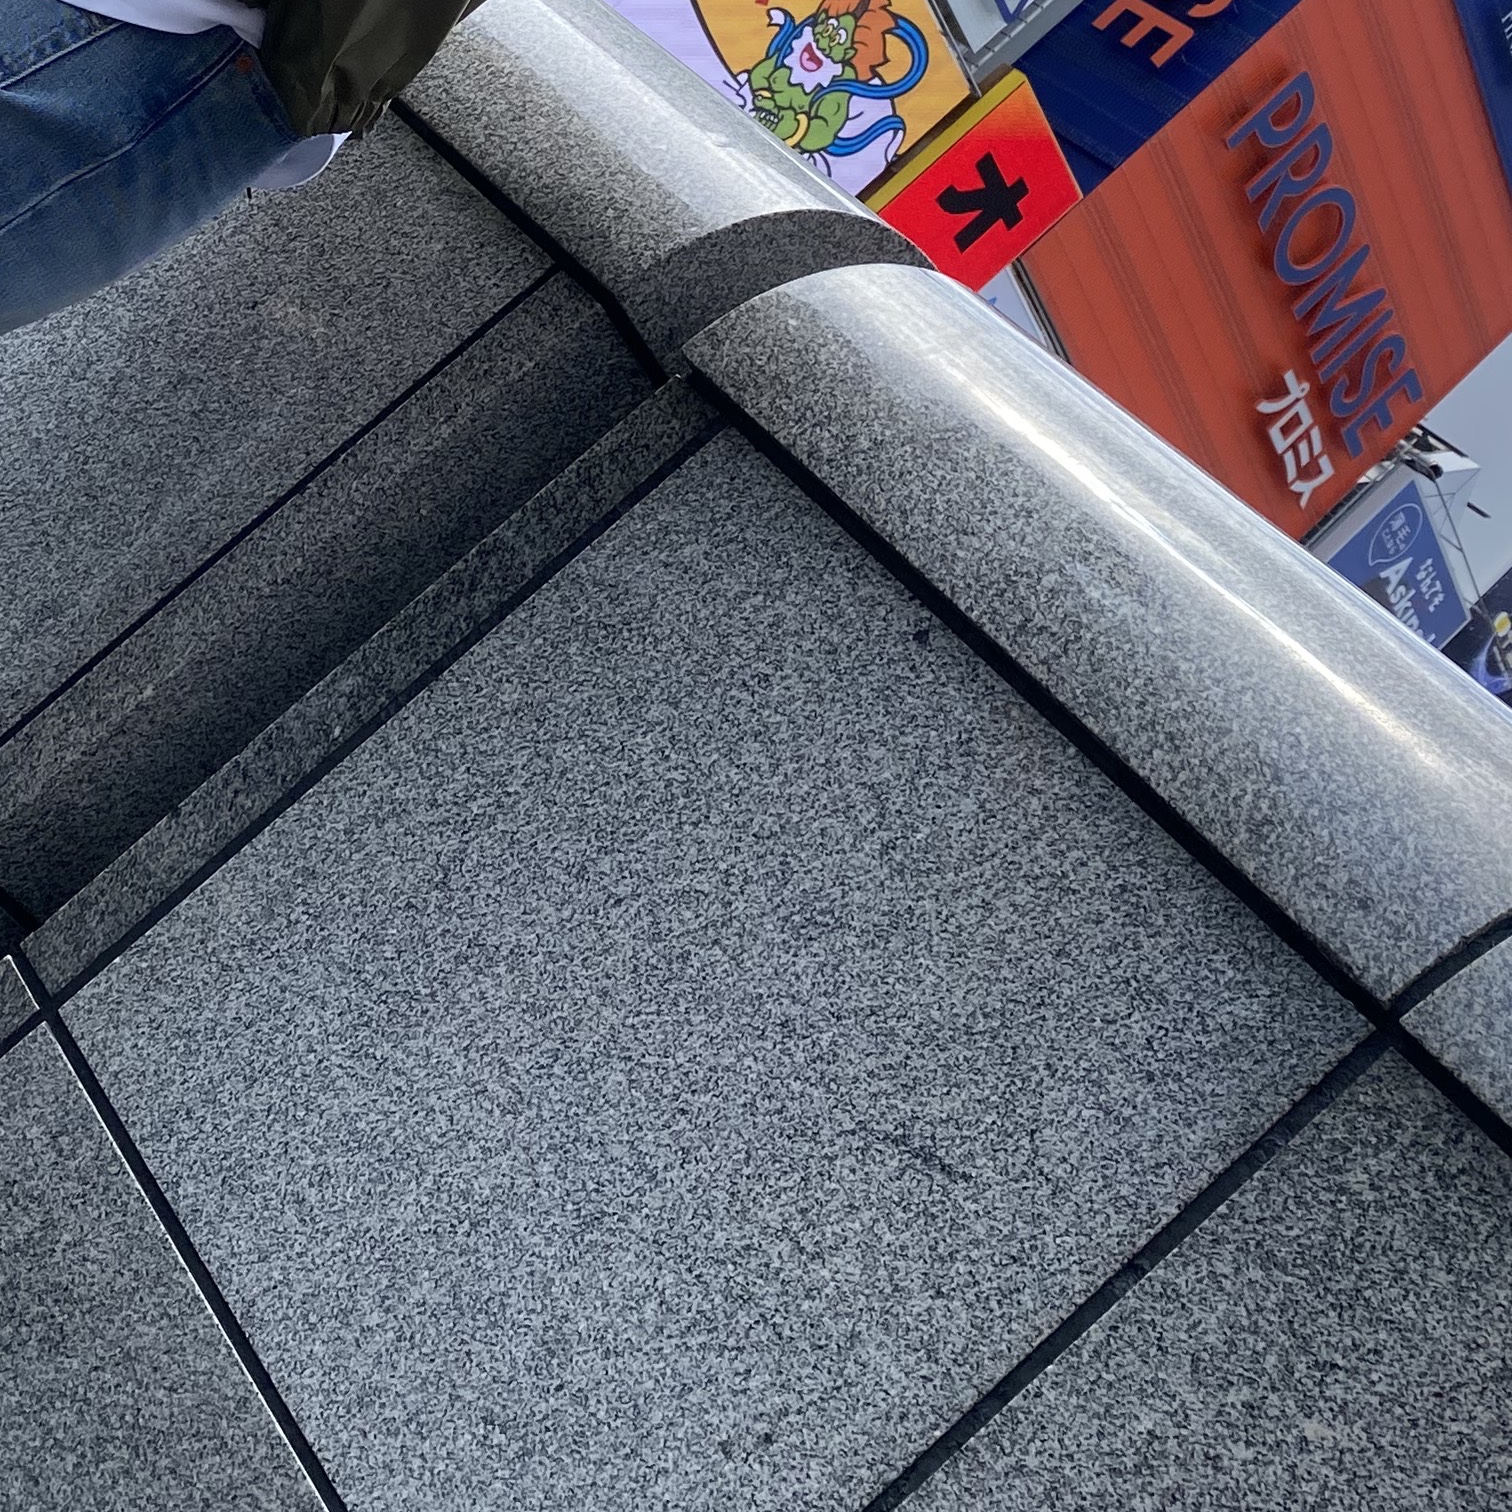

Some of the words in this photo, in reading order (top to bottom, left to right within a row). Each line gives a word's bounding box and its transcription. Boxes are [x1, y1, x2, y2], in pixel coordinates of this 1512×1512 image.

[1225, 70, 1424, 459] PROMISE
[1256, 369, 1335, 510] プロミス
